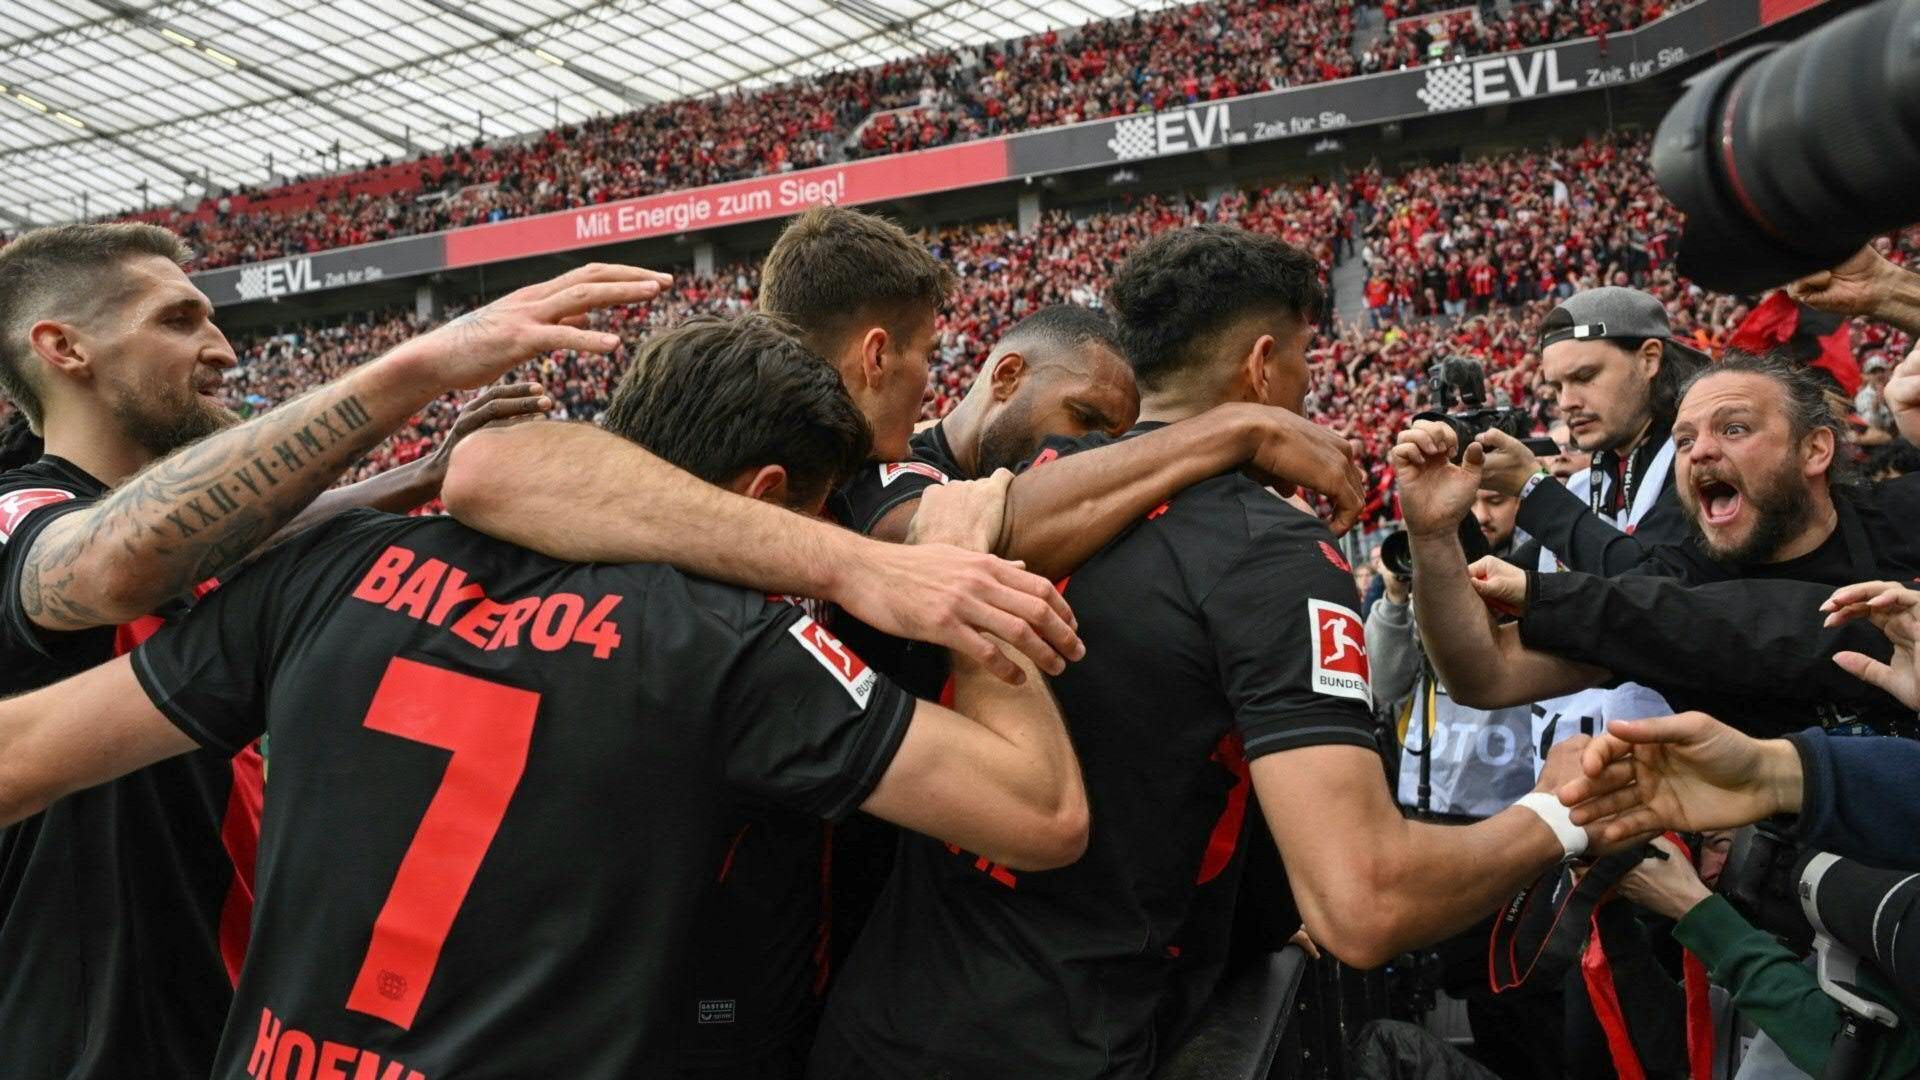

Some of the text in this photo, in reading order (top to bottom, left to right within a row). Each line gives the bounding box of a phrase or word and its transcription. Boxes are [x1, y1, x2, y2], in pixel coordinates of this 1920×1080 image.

[1473, 50, 1577, 104] EVL
[1586, 68, 1625, 87] Zeit
[1630, 62, 1654, 79] für
[1254, 121, 1287, 139] Zeit
[1291, 116, 1315, 133] für
[576, 171, 845, 239] Mit Energie zum Sieg!
[266, 258, 321, 296] EVL
[345, 656, 541, 1031] 7
